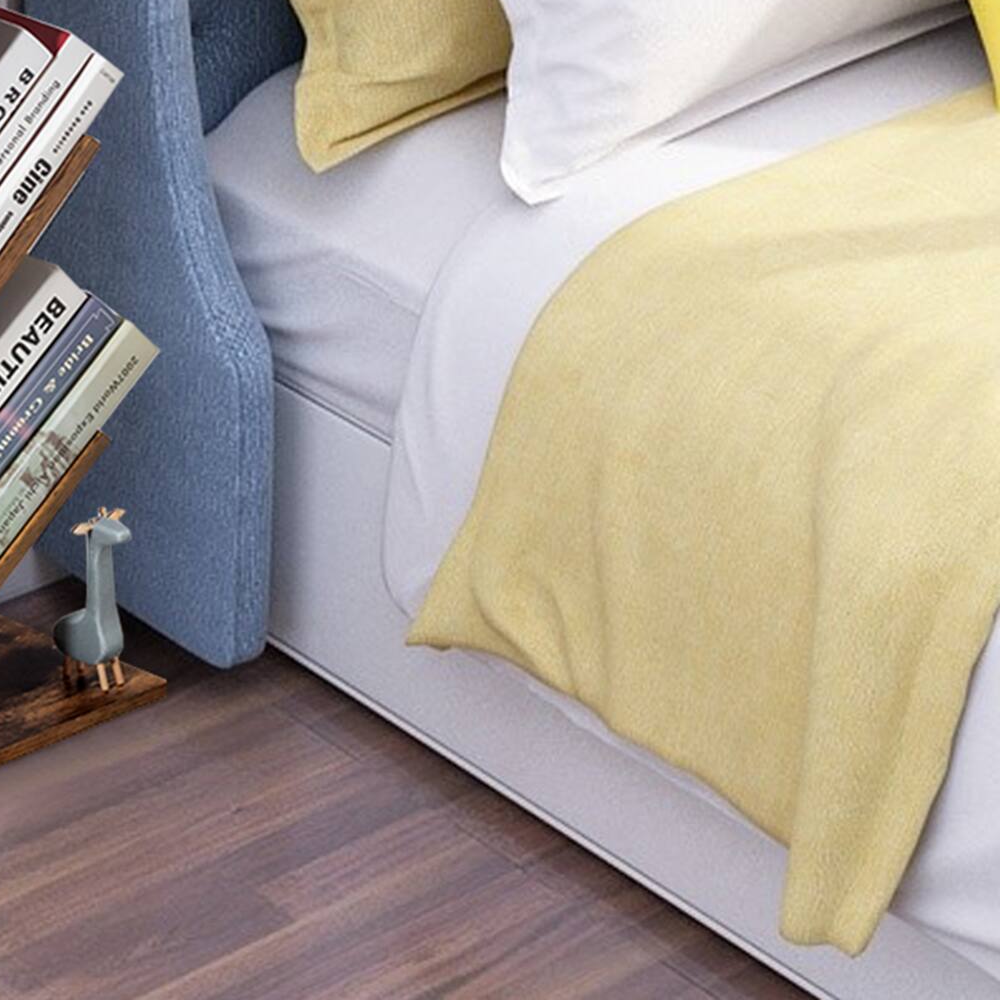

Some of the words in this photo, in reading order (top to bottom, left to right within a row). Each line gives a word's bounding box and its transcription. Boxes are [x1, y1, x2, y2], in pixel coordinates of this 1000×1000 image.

[24, 80, 61, 123] Branding
[13, 158, 52, 205] Cine
[58, 335, 94, 377] Bride
[44, 378, 57, 393] &
